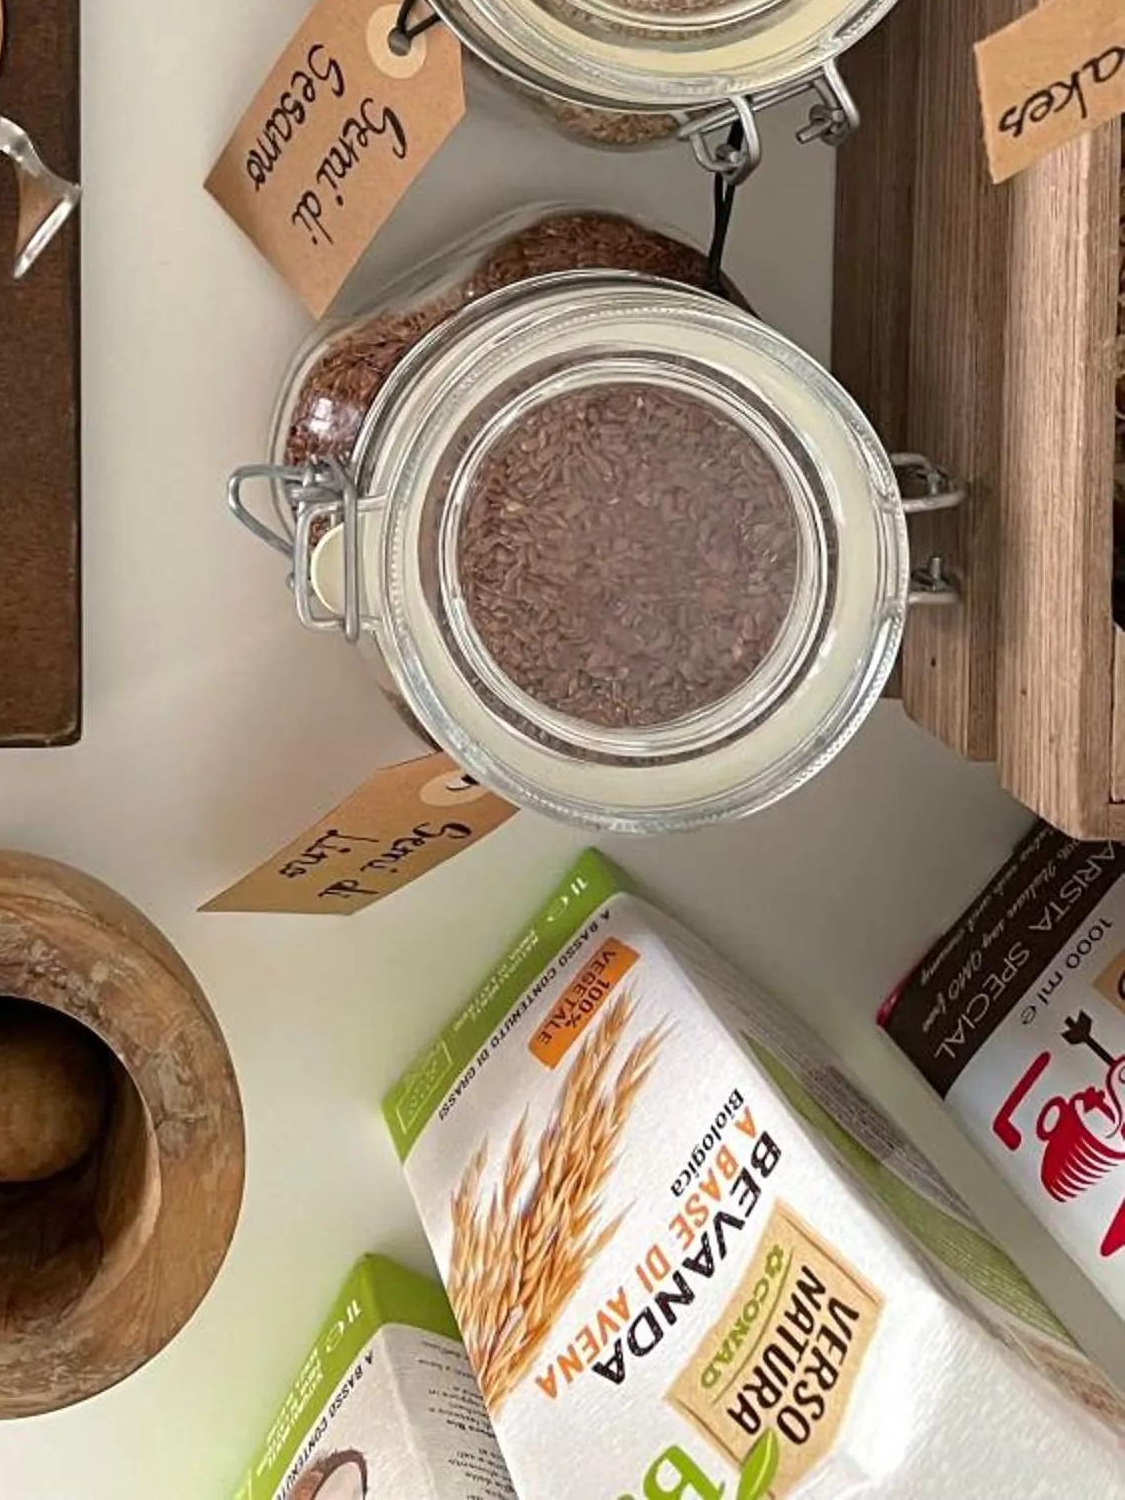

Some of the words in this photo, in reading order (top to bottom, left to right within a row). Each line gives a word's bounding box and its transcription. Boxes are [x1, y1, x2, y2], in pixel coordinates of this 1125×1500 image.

[998, 46, 1125, 138] akes
[316, 97, 408, 206] Semi
[291, 190, 334, 245] di
[600, 908, 611, 921] A
[1028, 840, 1116, 931] ARISTA
[558, 922, 600, 968] BASSO
[1066, 917, 1114, 969] 1000
[489, 969, 558, 1048] CONTENUTO
[539, 950, 617, 1046] VEGETALE
[564, 978, 611, 1029] 100%
[933, 941, 1031, 1059] SPECIAL
[1036, 971, 1064, 1006] ml
[438, 1070, 477, 1121] GRASSI
[476, 1050, 491, 1071] DI
[670, 1088, 745, 1198] Biologica
[734, 1105, 758, 1139] A
[669, 1143, 740, 1251] BASE
[591, 1130, 783, 1385] BEVANDA
[635, 1243, 673, 1295] DI
[363, 1350, 374, 1366] A
[535, 1285, 633, 1400] AVENA
[700, 1277, 771, 1390] CONAD
[727, 1265, 827, 1435] NATURA
[776, 1296, 861, 1446] VERSO
[329, 1363, 364, 1419] BASSO
